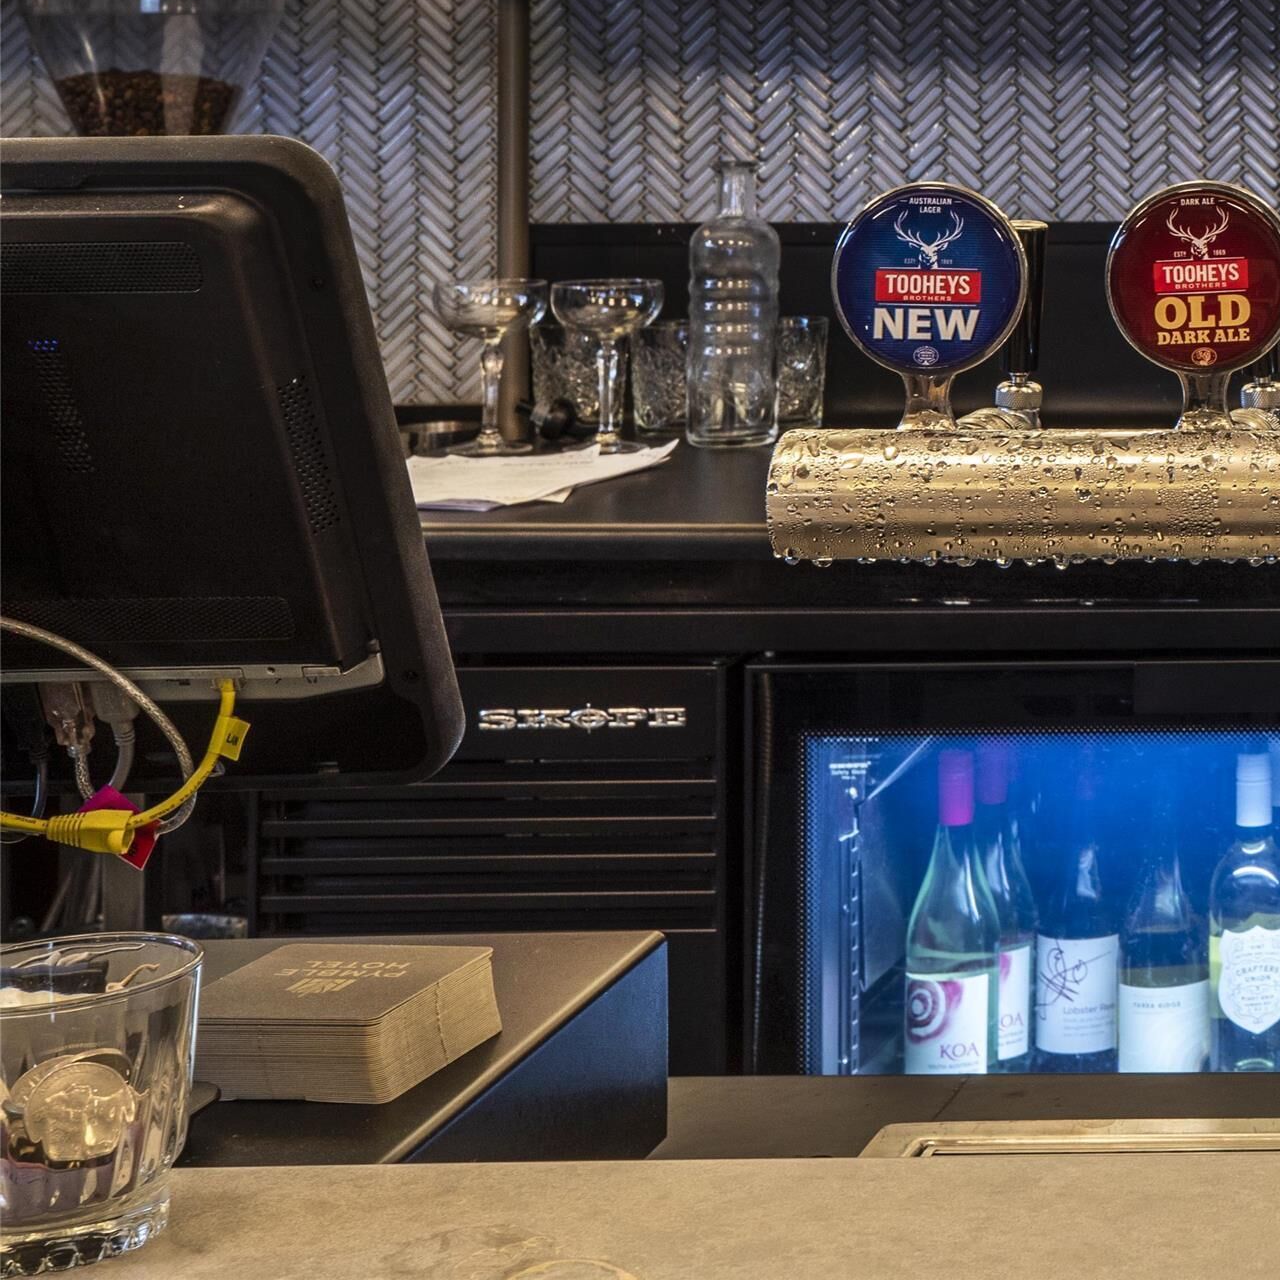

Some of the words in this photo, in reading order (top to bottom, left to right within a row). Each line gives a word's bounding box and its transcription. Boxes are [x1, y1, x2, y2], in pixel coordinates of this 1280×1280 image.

[908, 197, 952, 205] AUSTRALIAN
[1162, 263, 1240, 284] TOOHEYS
[885, 274, 971, 295] TOOHEYS
[1154, 294, 1251, 330] OLD
[873, 308, 980, 341] NEW
[1157, 331, 1211, 345] DARK
[1213, 328, 1250, 343] ALE
[274, 968, 406, 978] PYMBLE
[306, 959, 411, 969] HOTEL
[939, 1043, 980, 1061] KOA
